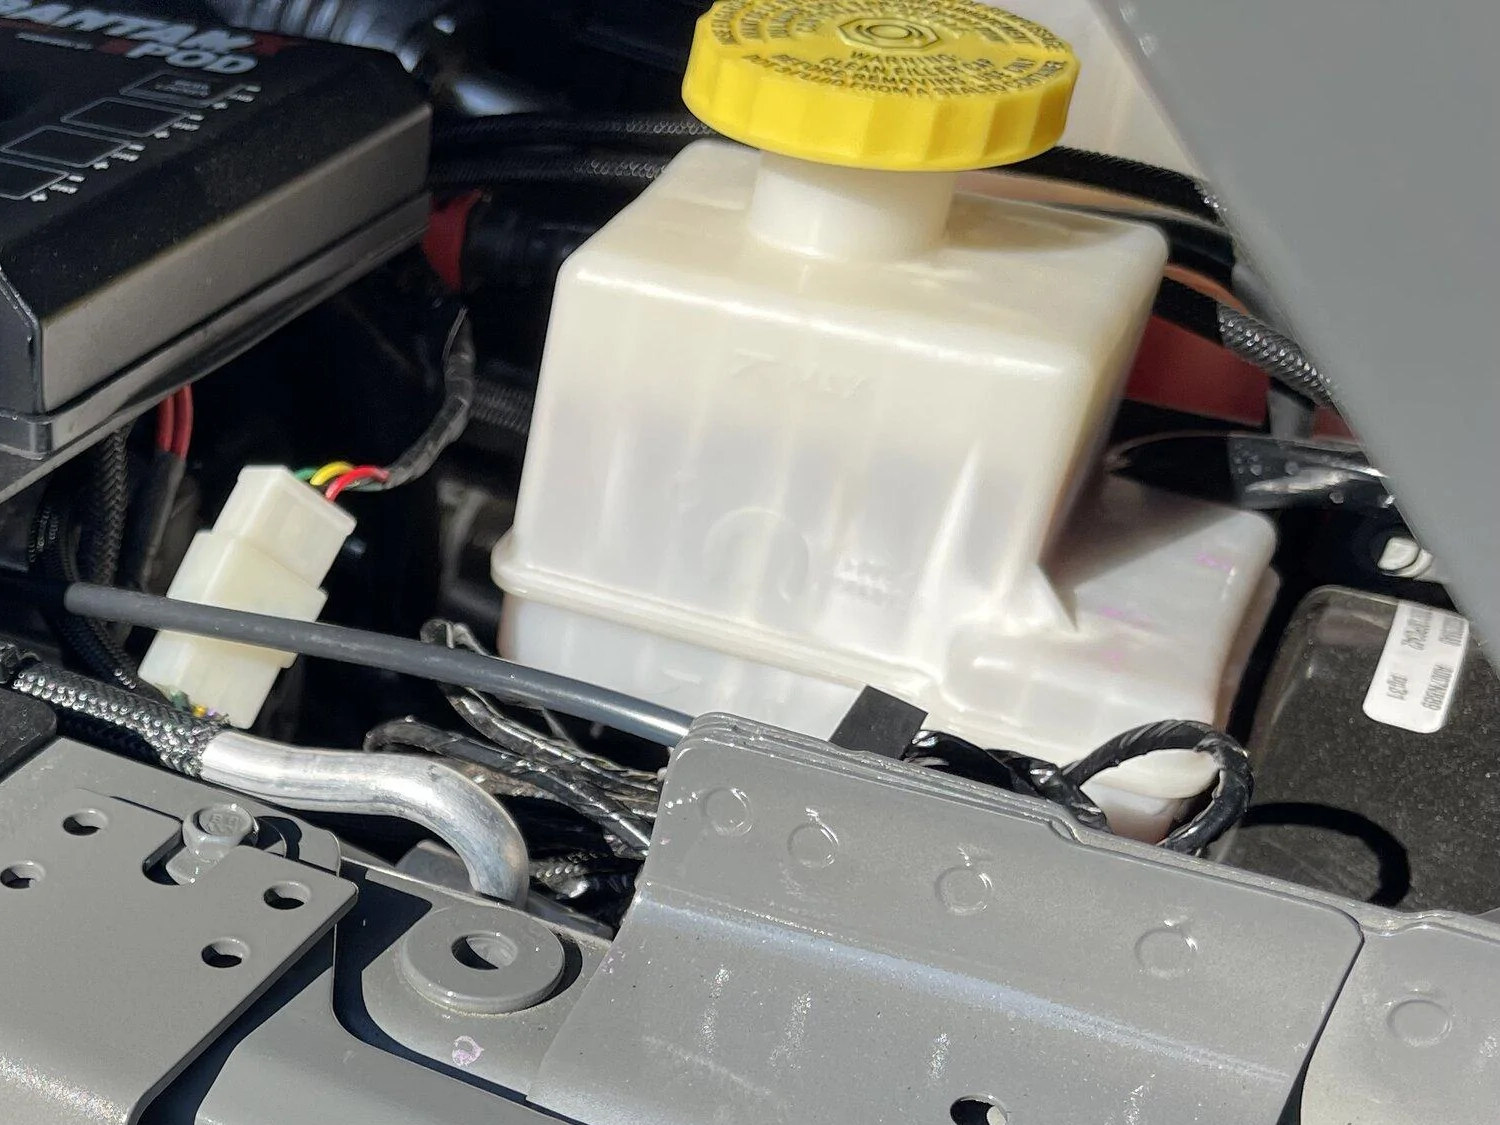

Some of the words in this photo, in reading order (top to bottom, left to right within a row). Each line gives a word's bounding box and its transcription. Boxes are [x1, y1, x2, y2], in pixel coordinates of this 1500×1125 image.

[124, 42, 258, 74] POD
[820, 57, 887, 74] CLEAN
[894, 65, 964, 77] FILLER
[850, 81, 909, 94] FROM
